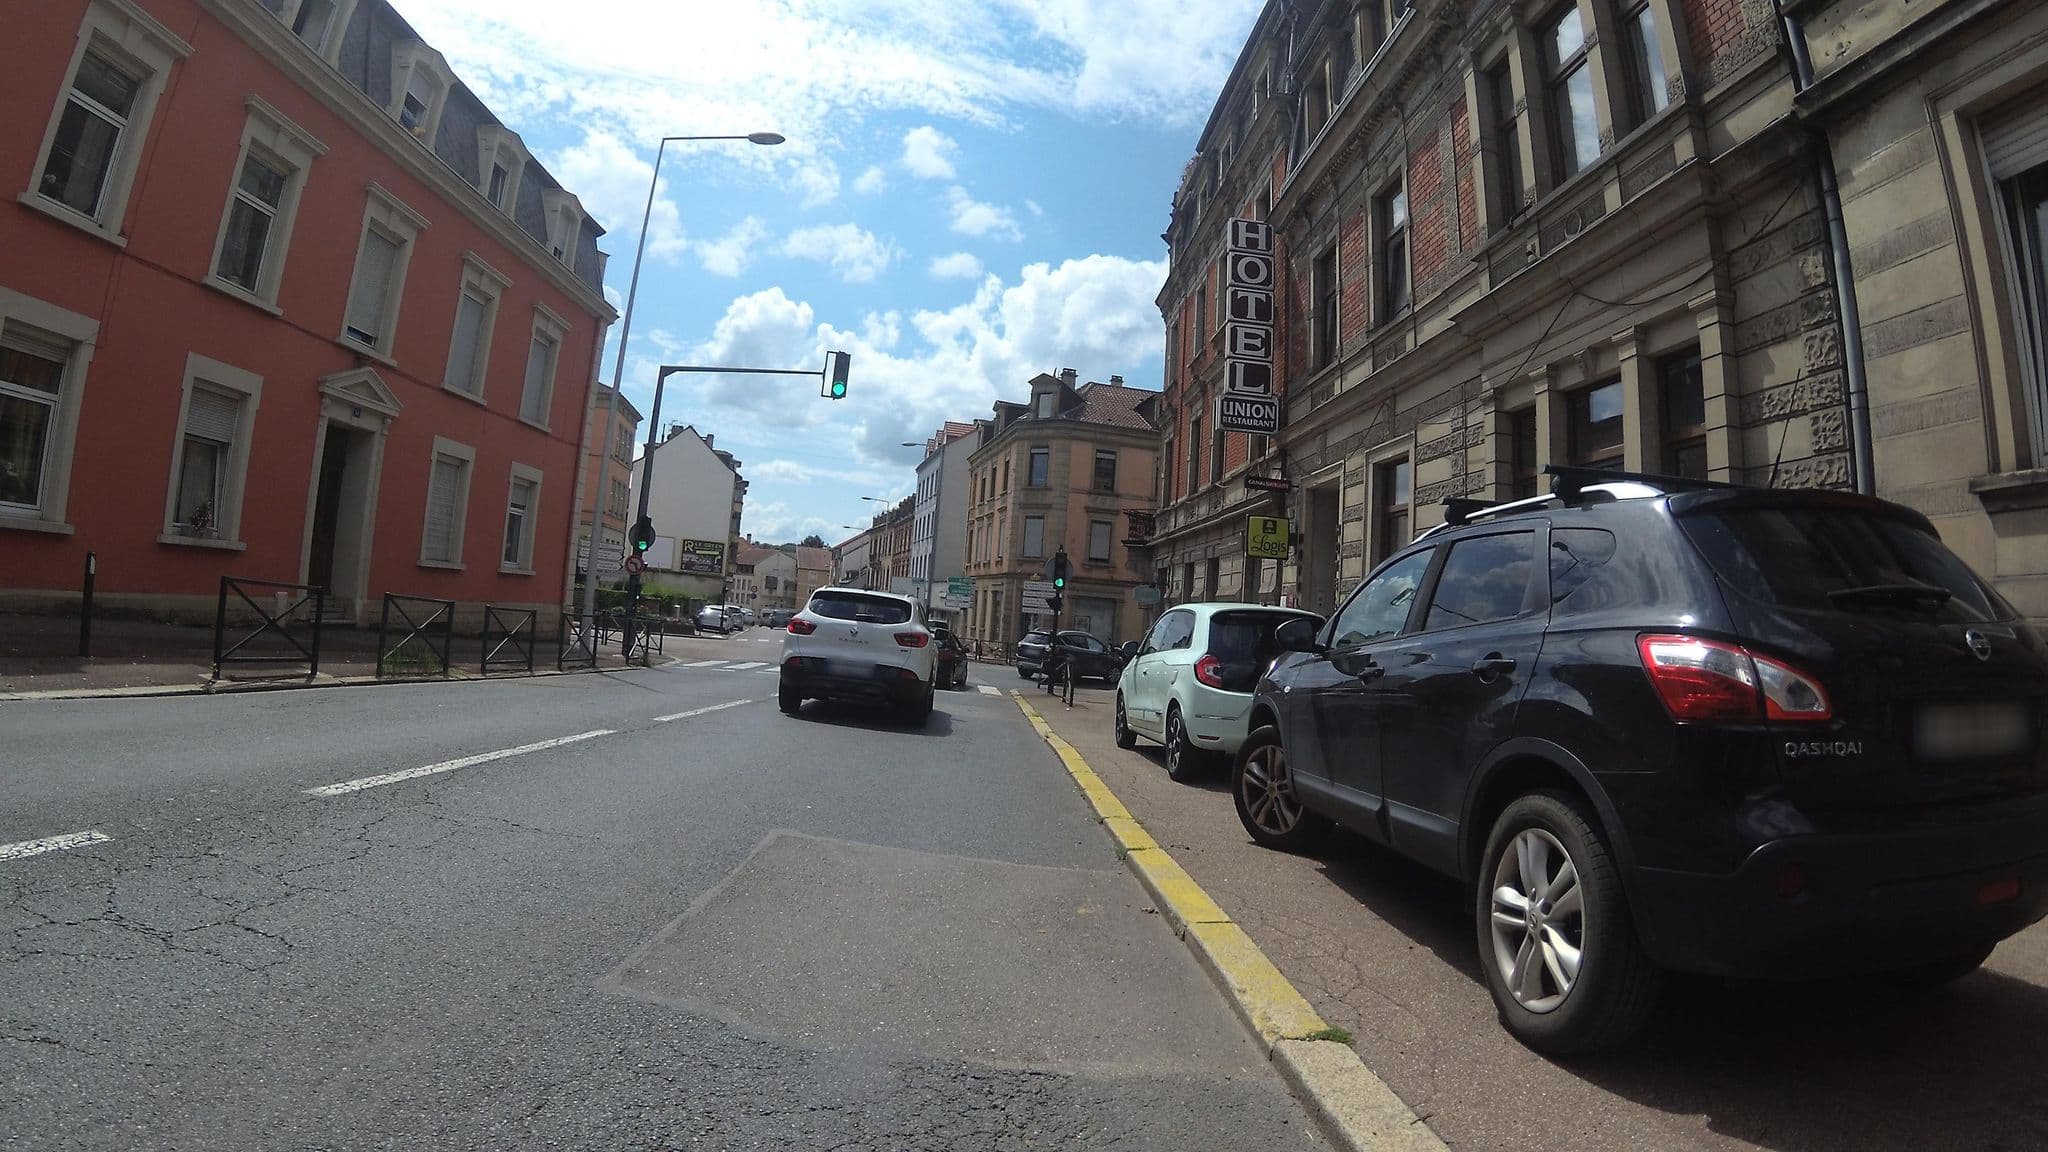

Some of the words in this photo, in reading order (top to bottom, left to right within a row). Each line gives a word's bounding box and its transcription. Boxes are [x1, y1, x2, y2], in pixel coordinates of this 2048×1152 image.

[1234, 220, 1268, 394] HOTEL
[1223, 401, 1275, 419] UNION
[1222, 416, 1275, 428] RESTAURANT
[1250, 534, 1287, 556] Logis
[1785, 742, 1862, 757] QASHQAI
